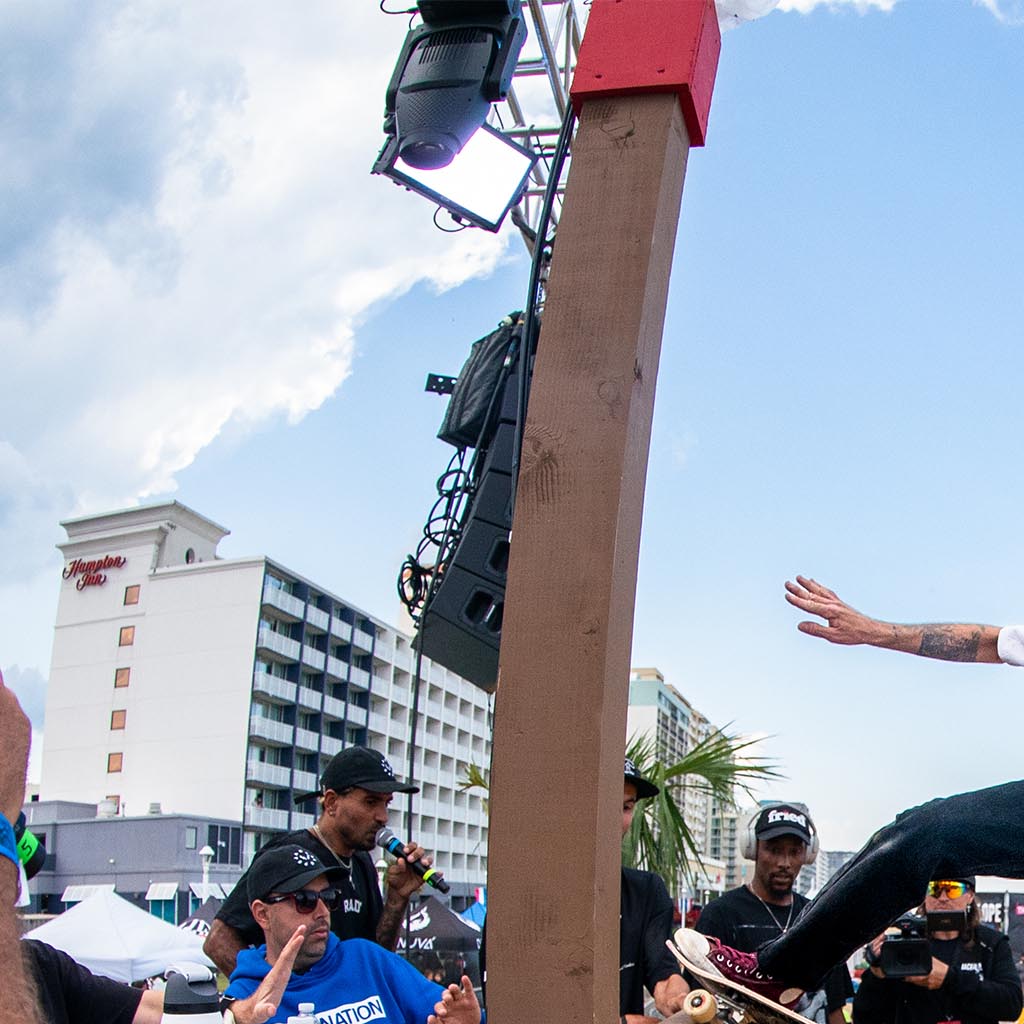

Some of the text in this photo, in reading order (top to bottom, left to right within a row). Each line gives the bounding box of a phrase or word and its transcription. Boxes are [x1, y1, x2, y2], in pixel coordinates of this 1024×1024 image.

[62, 555, 126, 579] Hampton
[76, 572, 107, 591] Inn
[768, 810, 806, 828] fried
